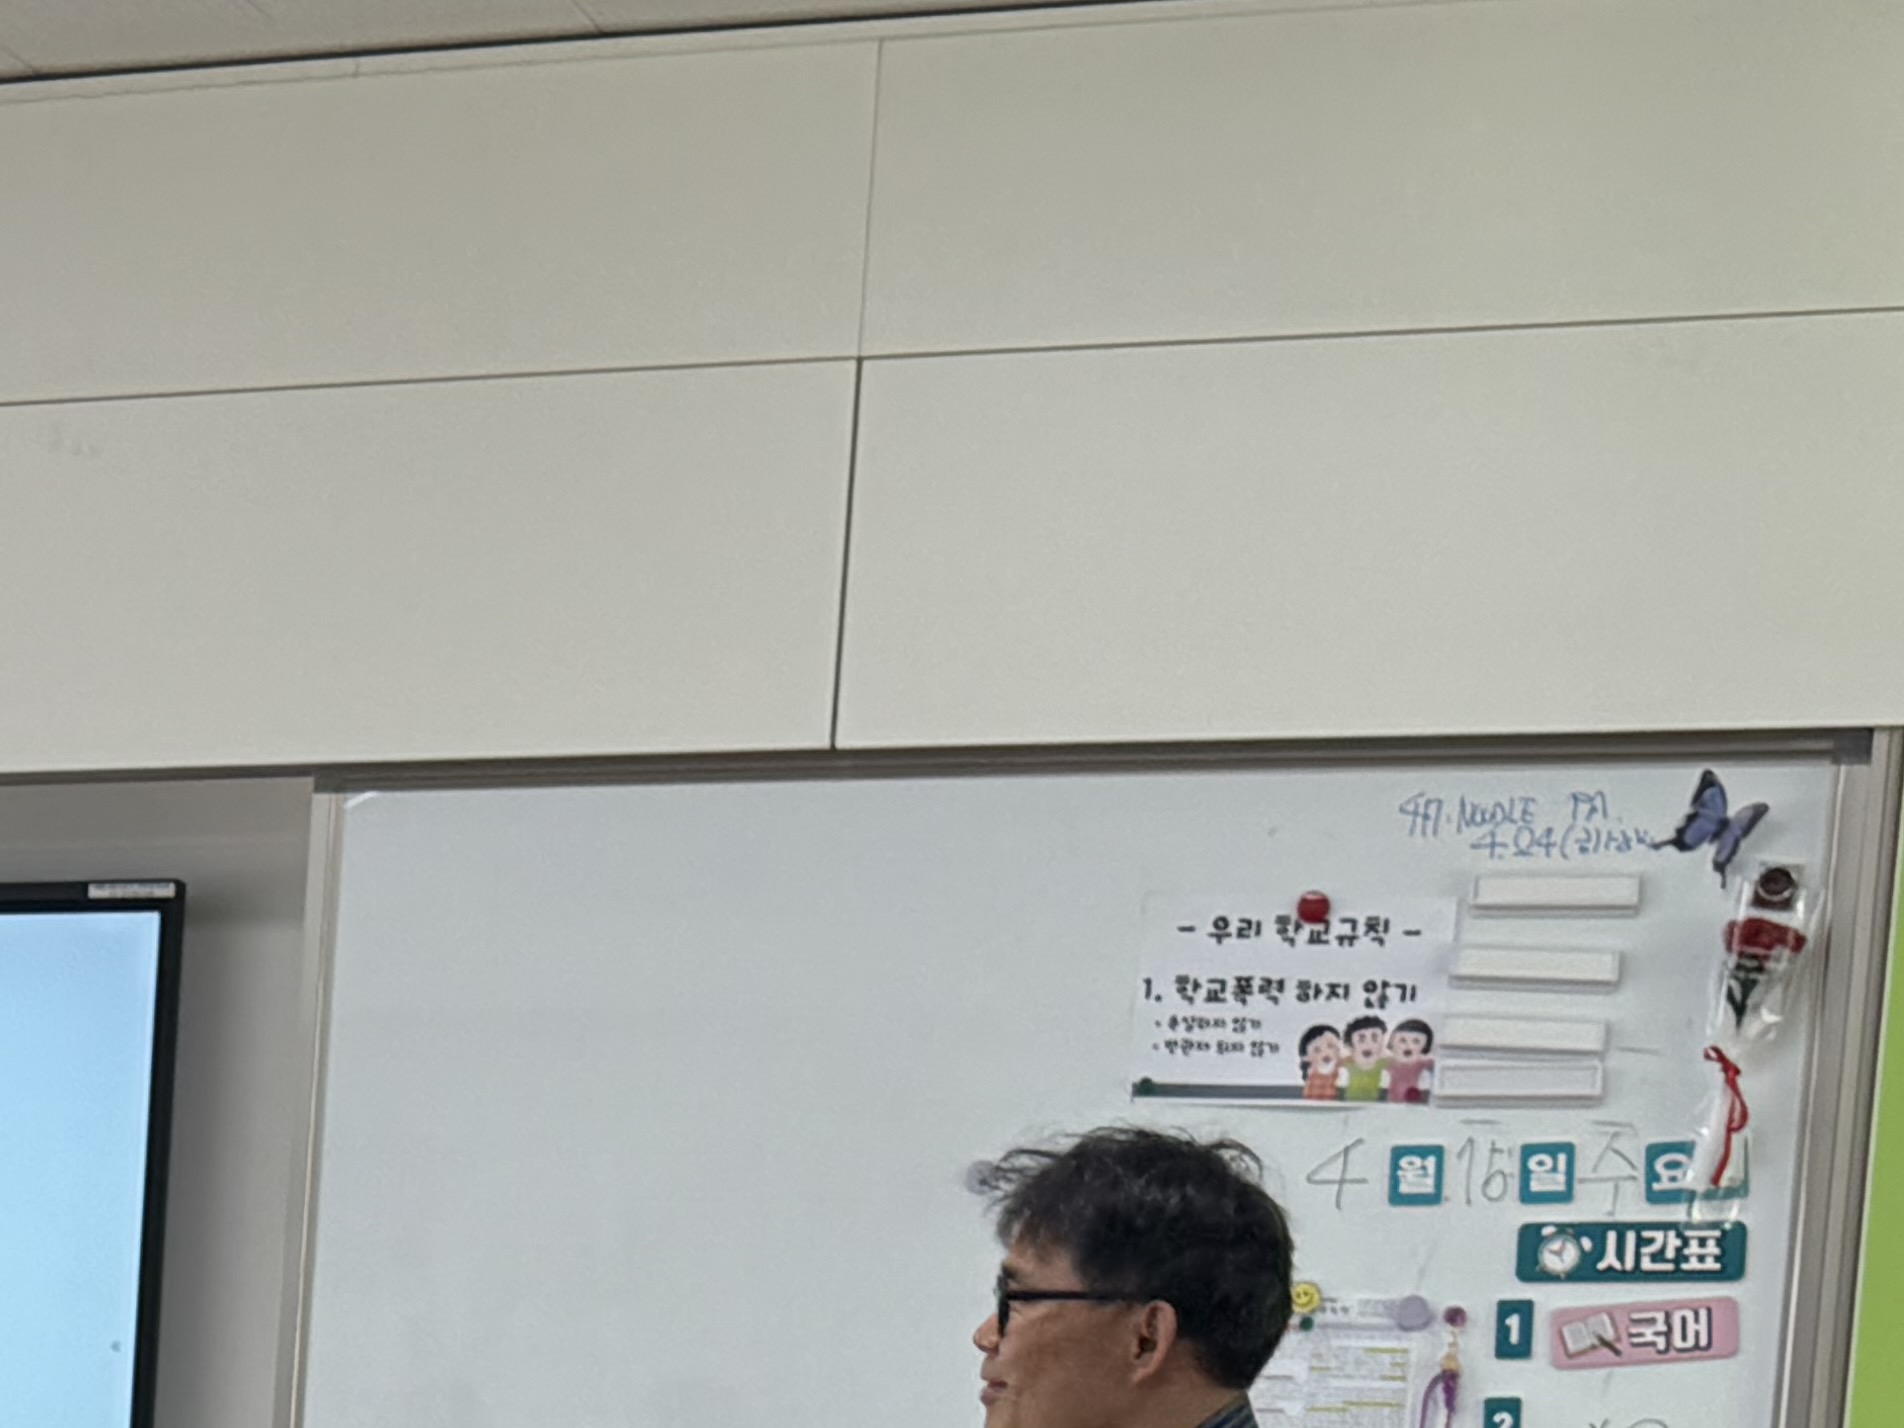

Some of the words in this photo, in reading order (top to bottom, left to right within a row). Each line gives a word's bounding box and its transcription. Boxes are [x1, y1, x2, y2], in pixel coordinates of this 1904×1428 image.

[1207, 915, 1262, 945] 우리
[1274, 914, 1390, 947] 학교규칙
[1142, 976, 1163, 1002] 1.
[1173, 974, 1285, 1005] 학교폭력
[1295, 979, 1350, 1002] 하지
[1362, 979, 1417, 1010] 않기
[1305, 1138, 1369, 1210] 4
[1396, 1155, 1437, 1194] 월
[1526, 1151, 1568, 1193] 일
[1596, 1230, 1724, 1274] 시간표
[1505, 1313, 1521, 1344] 1
[1628, 1308, 1712, 1353] 국어
